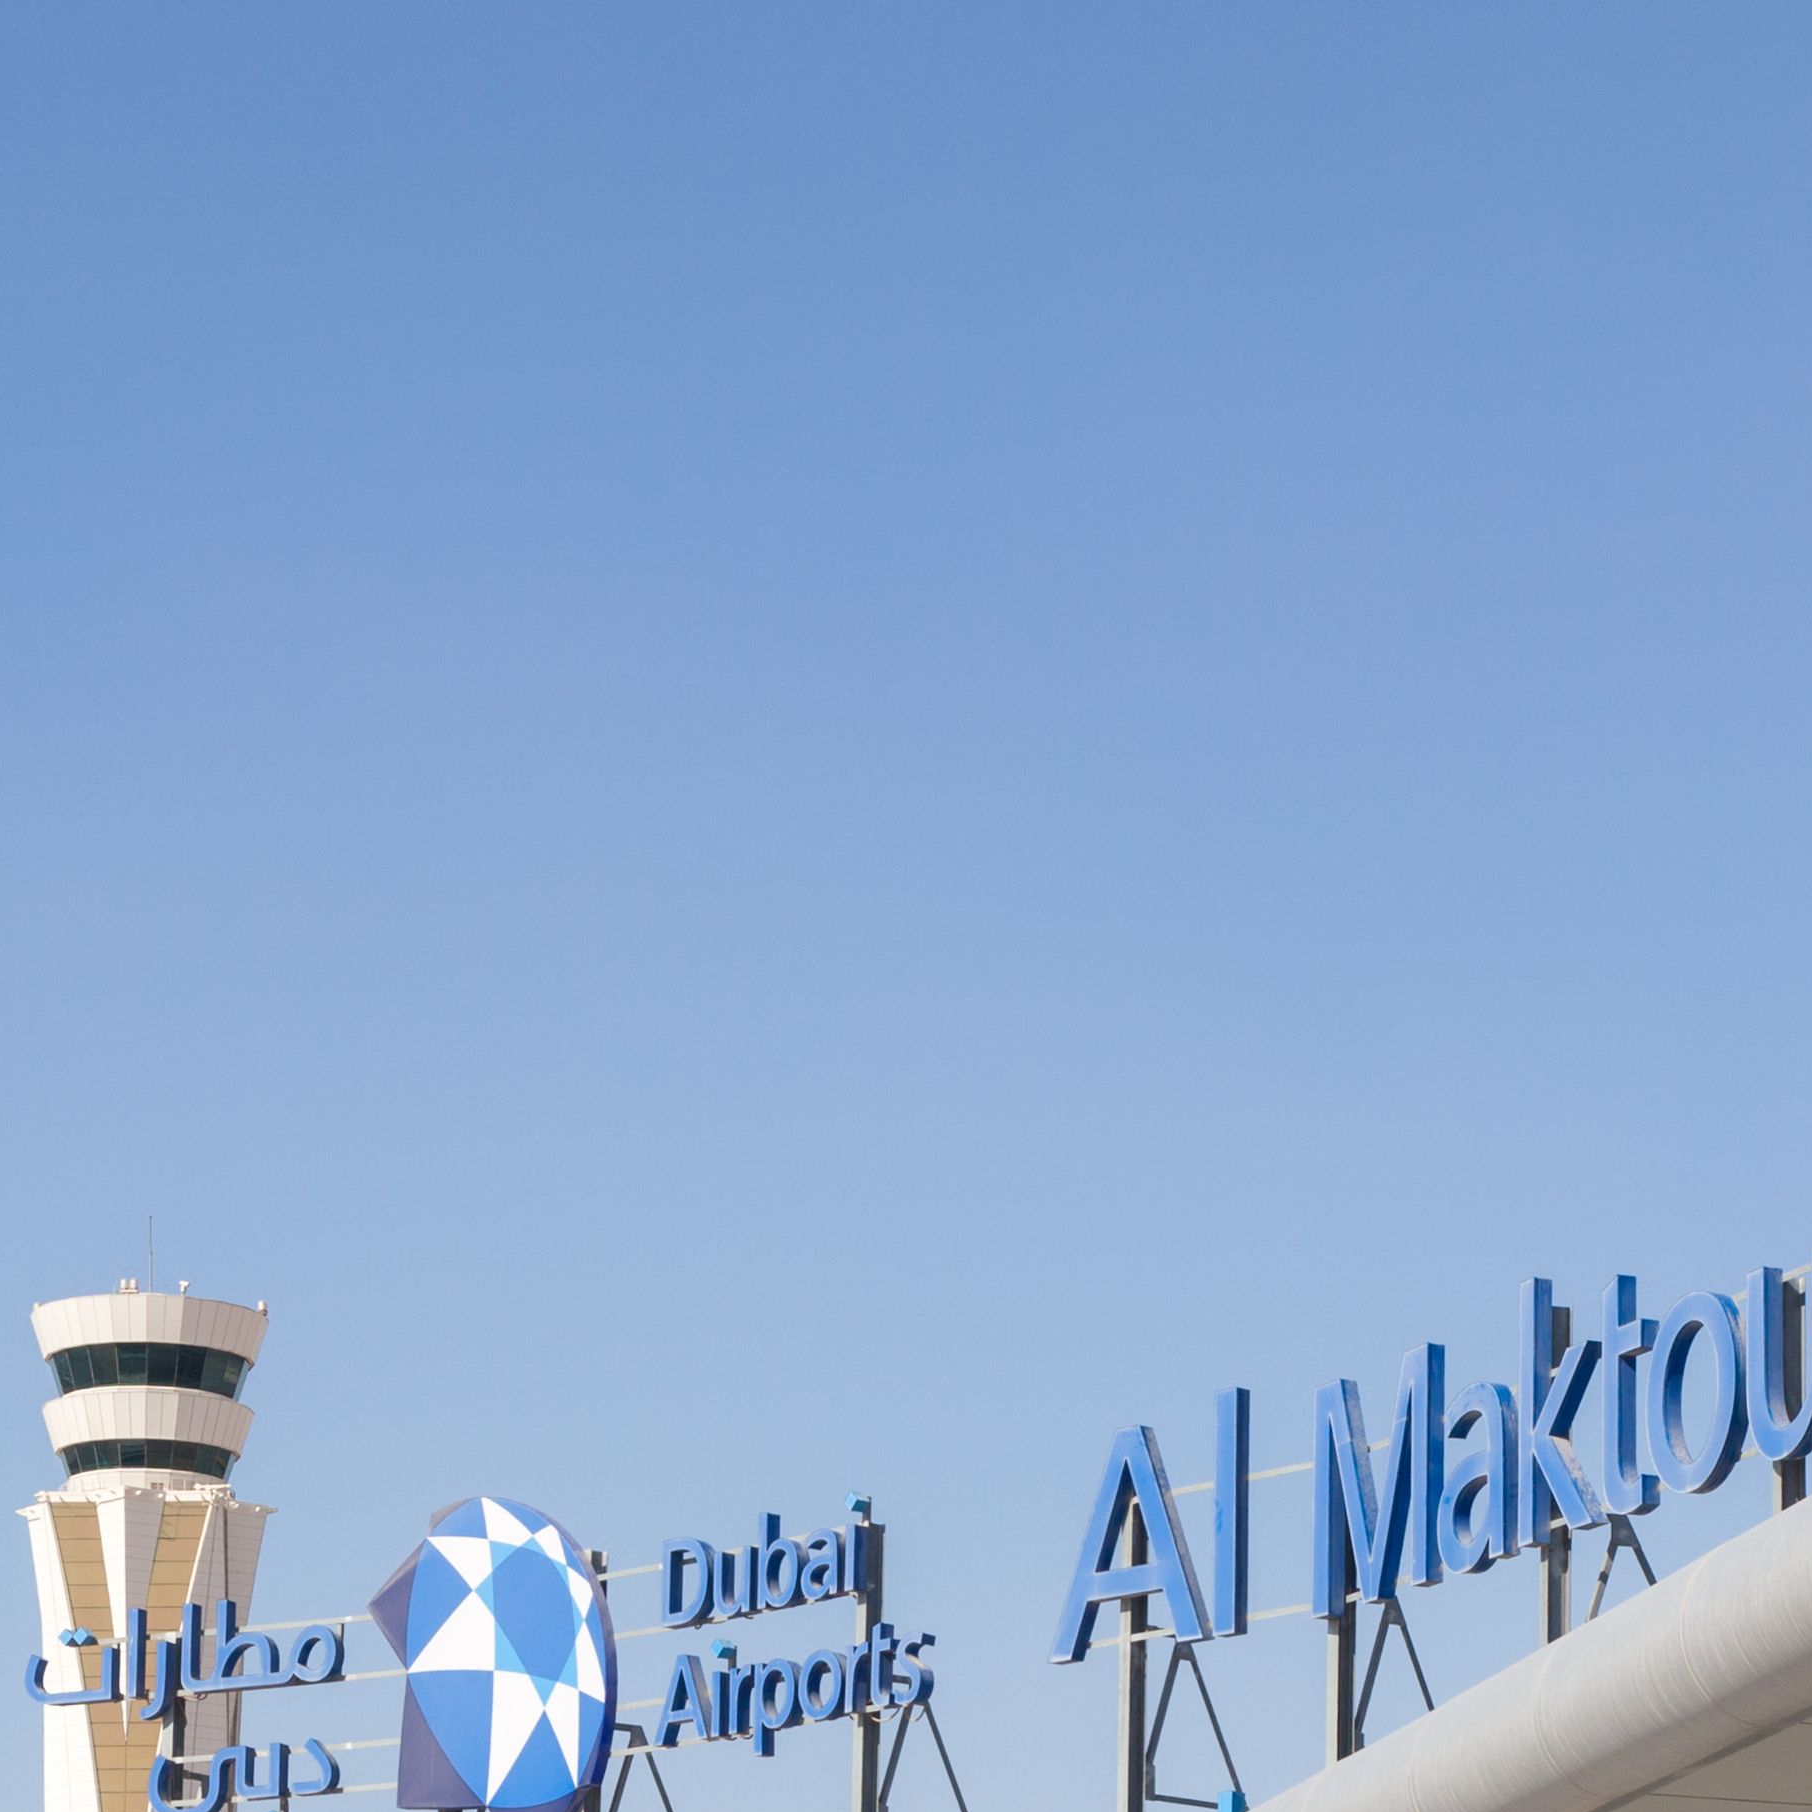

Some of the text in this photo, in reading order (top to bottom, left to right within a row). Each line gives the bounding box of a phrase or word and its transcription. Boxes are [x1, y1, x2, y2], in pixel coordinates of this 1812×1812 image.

[660, 1491, 872, 1628] Dubai
[1049, 1386, 1249, 1664] Al
[24, 1598, 344, 1721] مطارات
[655, 1622, 937, 1757] Airports
